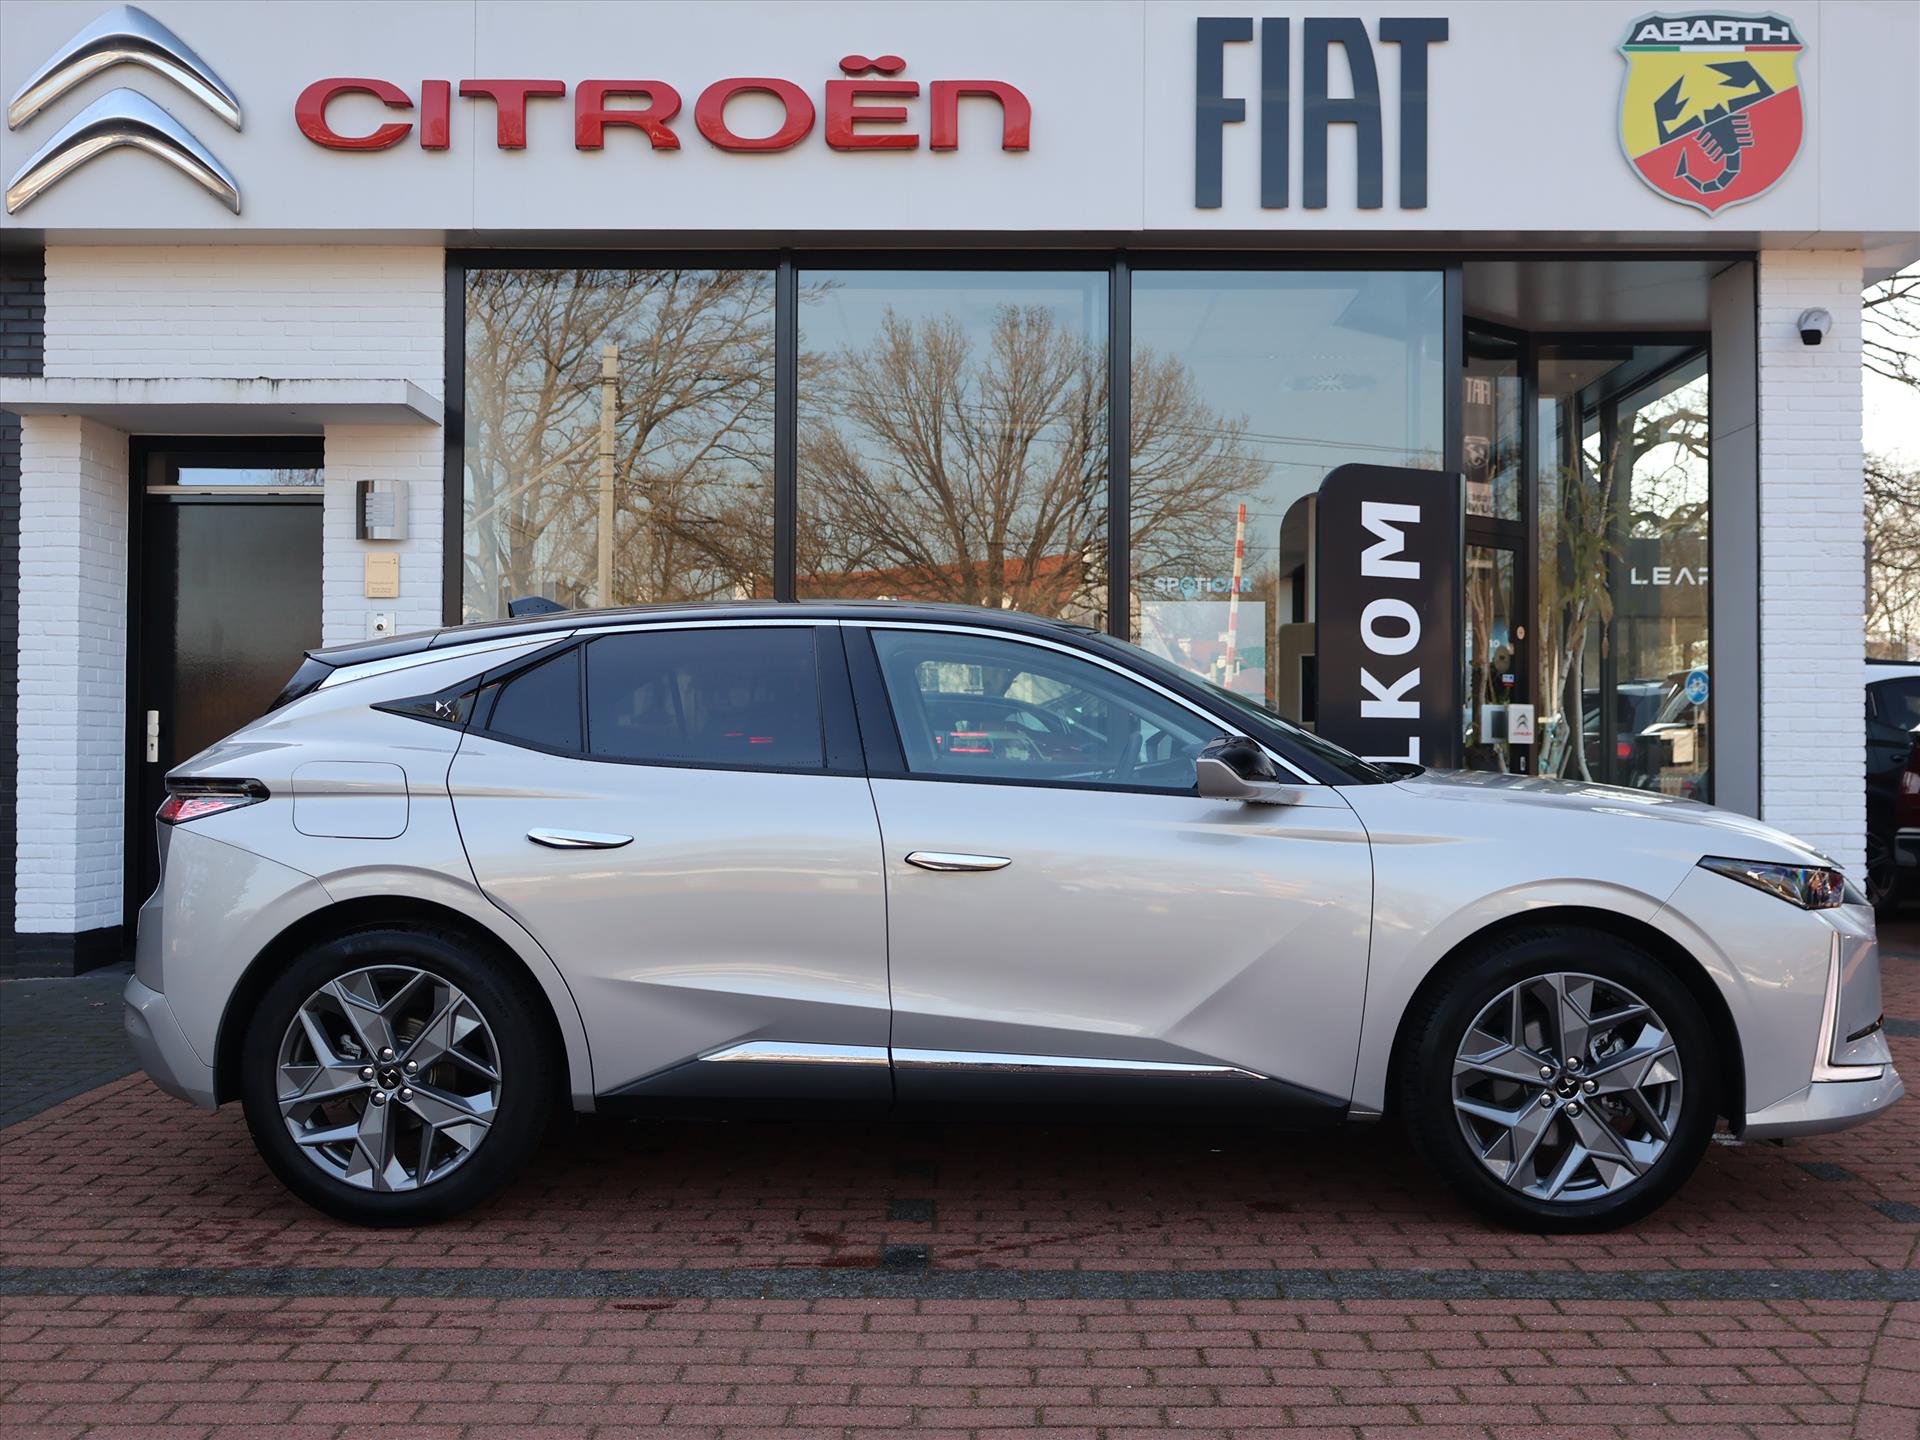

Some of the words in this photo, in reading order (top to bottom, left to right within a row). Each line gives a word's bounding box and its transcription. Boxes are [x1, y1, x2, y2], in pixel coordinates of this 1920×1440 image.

[1635, 20, 1789, 41] ABARTH
[294, 54, 1032, 152] CITROËN
[1195, 17, 1449, 209] FIAT
